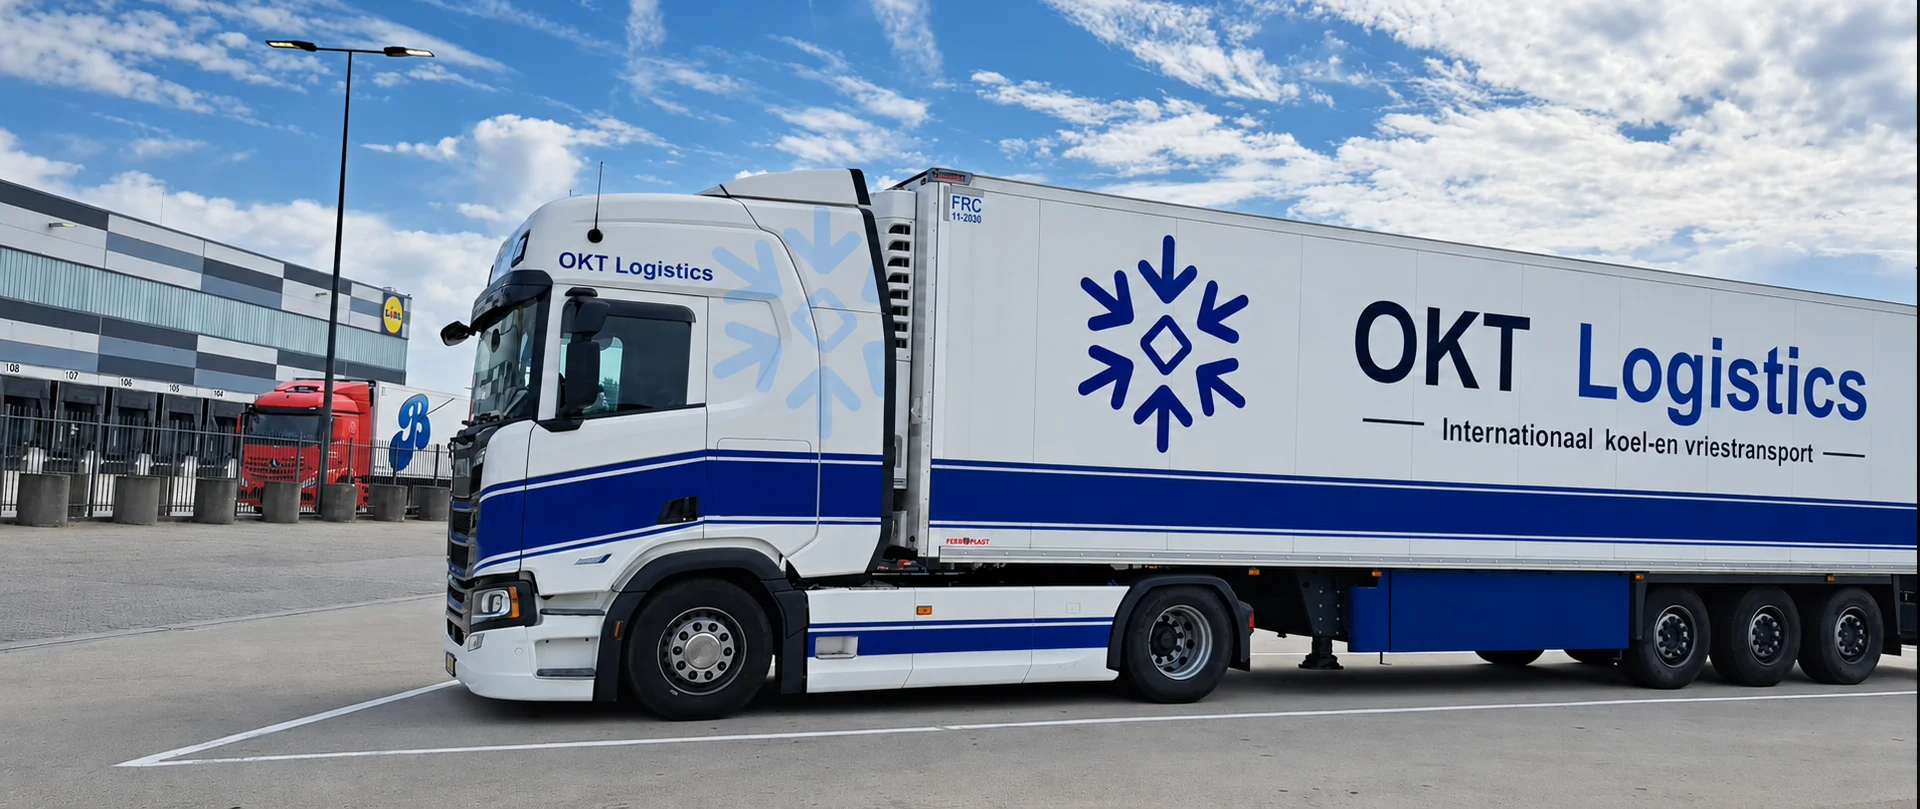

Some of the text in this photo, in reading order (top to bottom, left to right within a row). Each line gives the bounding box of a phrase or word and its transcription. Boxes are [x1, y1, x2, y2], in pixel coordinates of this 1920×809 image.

[952, 195, 982, 213] FRC
[952, 212, 982, 224] 11-2030
[559, 252, 713, 281] OKT Logistics
[6, 363, 20, 373] 108
[1355, 300, 1867, 426] OKT Logistics
[65, 371, 79, 380] 107
[120, 378, 133, 387] 106
[169, 384, 180, 393] 105
[1443, 417, 1814, 466] Internationaal koel-en vriestransport
